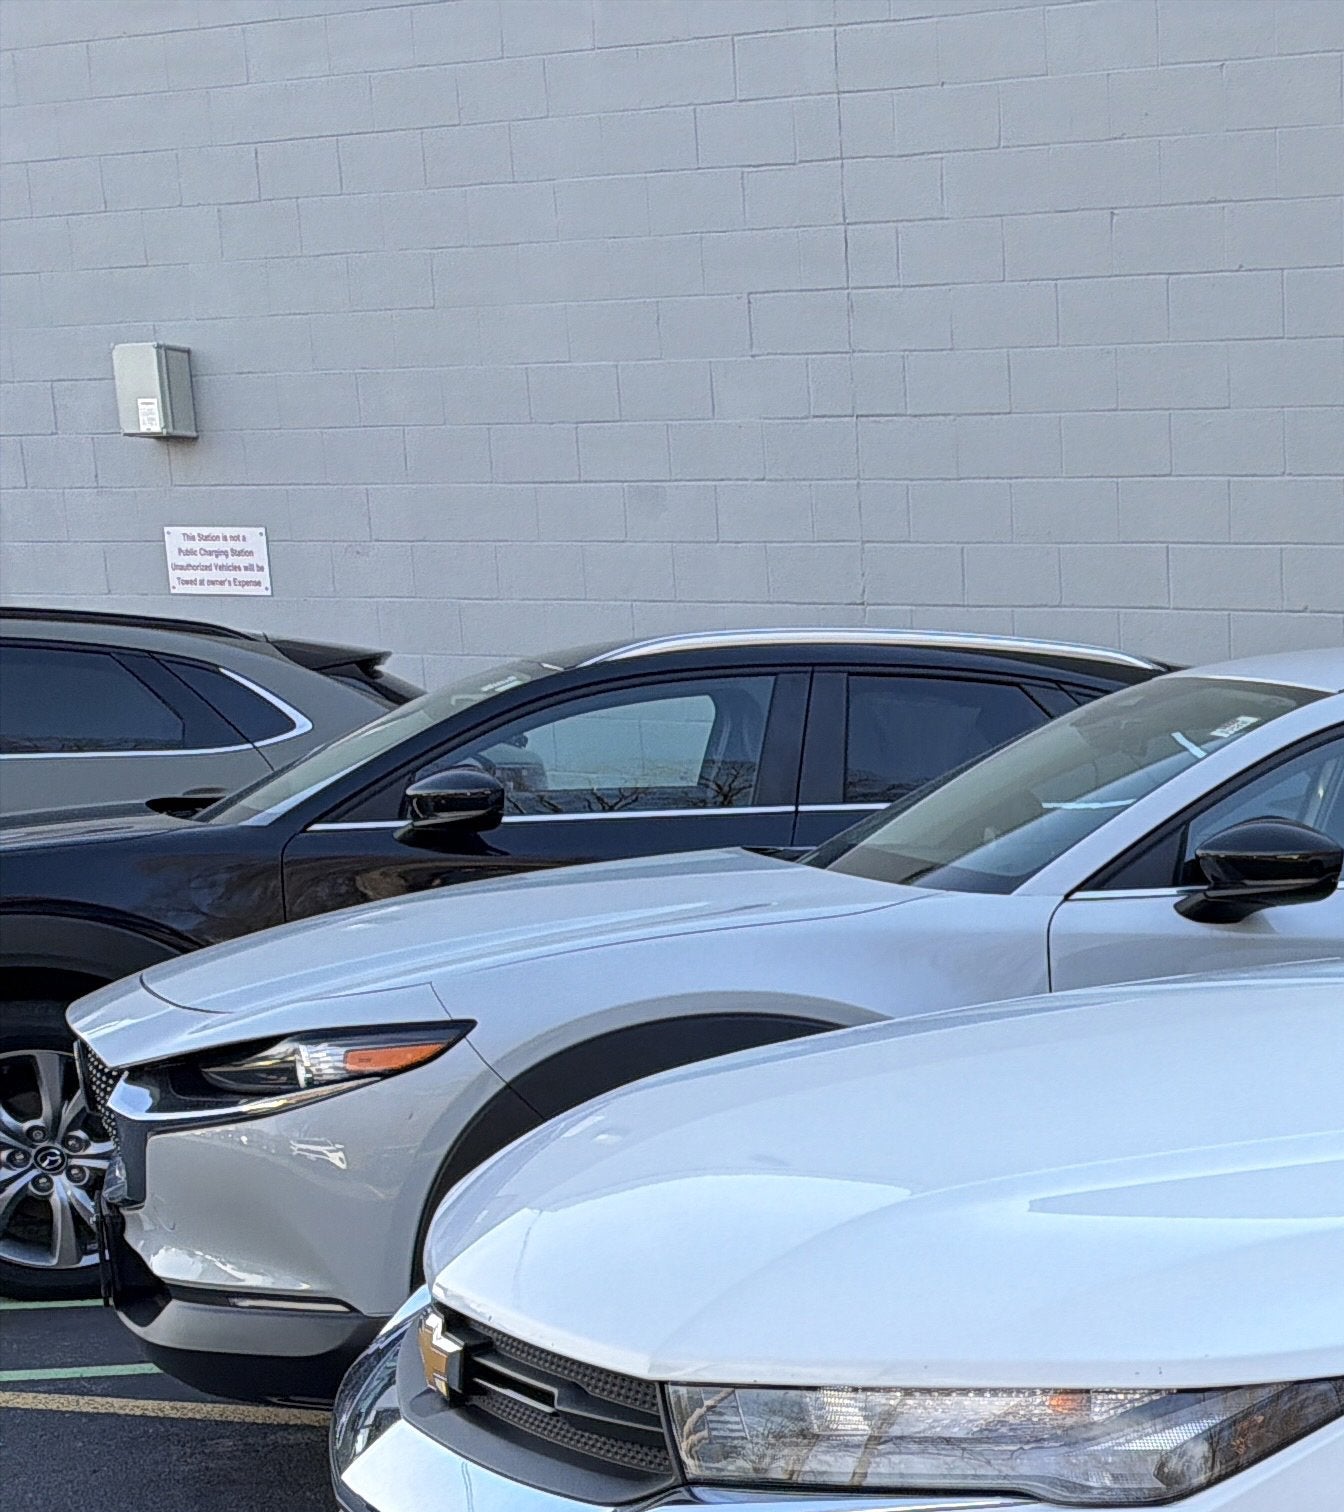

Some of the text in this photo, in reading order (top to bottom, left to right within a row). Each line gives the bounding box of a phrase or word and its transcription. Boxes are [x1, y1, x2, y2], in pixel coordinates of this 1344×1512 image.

[182, 533, 195, 541] This
[198, 533, 220, 542] Station
[222, 533, 228, 541] is
[229, 534, 239, 542] not
[178, 548, 254, 559] Public Charging Station
[171, 563, 264, 572] Unauthorized Vehicles will be
[176, 577, 261, 588] Towed at owner's Expense
